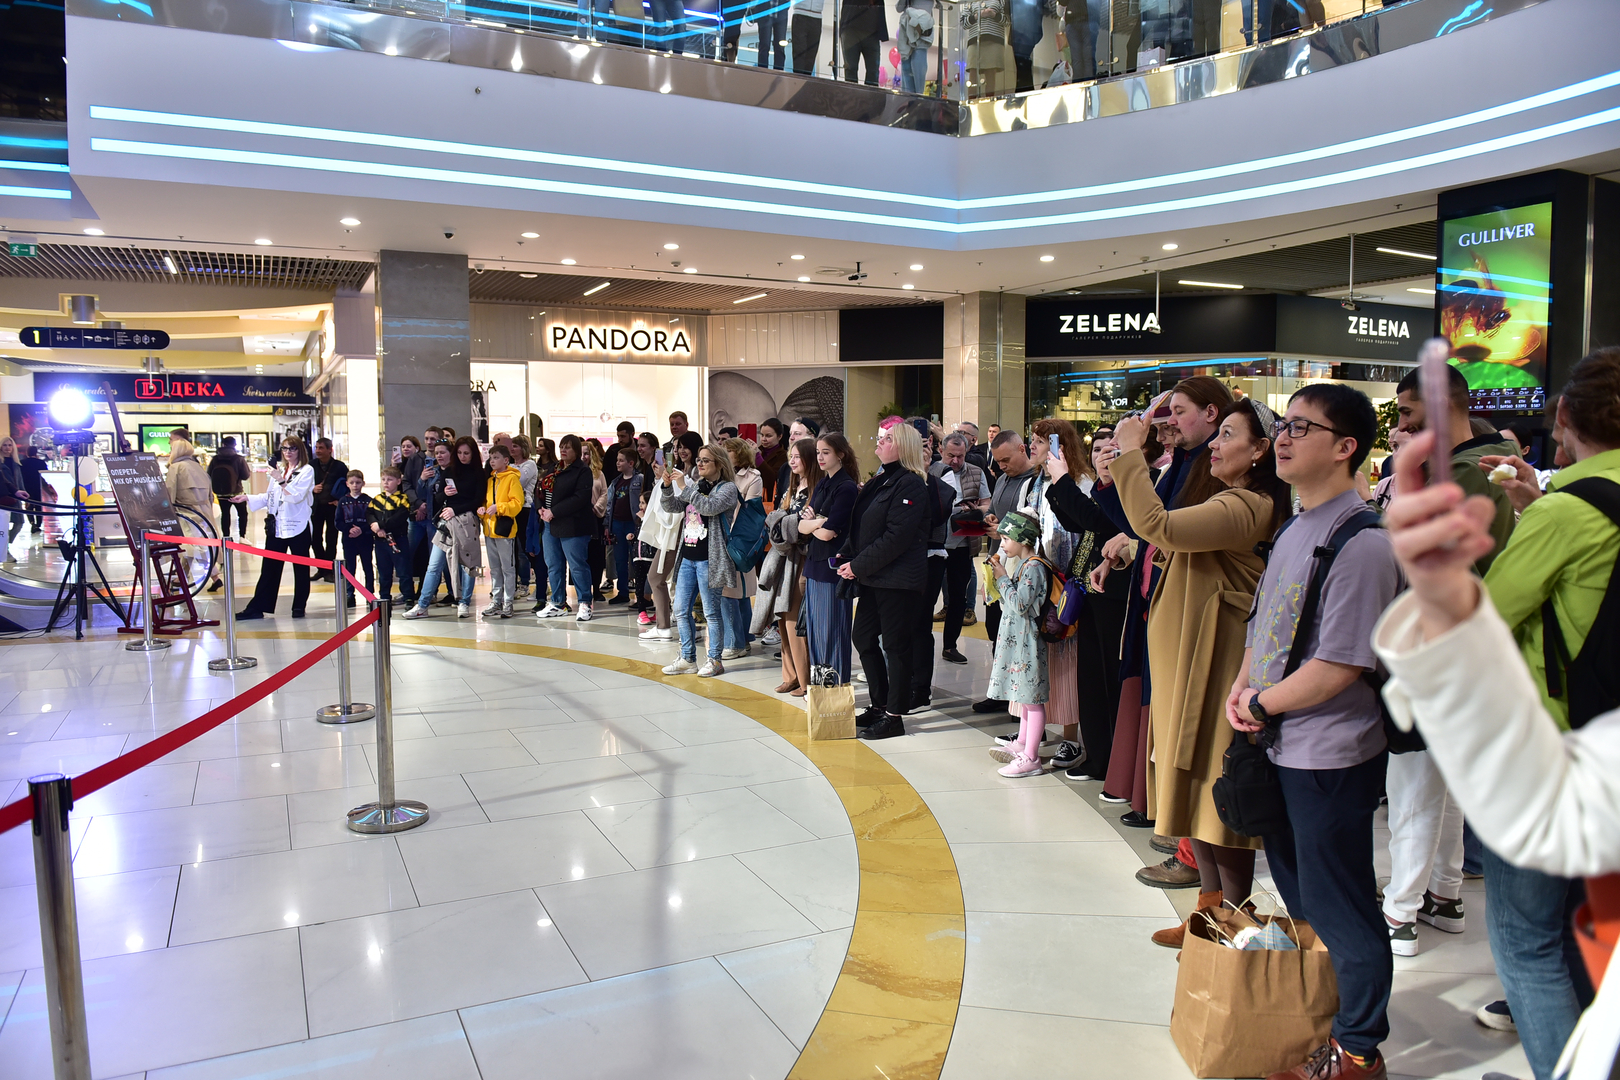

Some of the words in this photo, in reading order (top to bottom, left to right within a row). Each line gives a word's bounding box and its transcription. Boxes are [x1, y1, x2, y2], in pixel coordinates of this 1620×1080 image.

[1458, 222, 1535, 247] GULLIVER
[1059, 312, 1161, 333] ZELENA
[1347, 315, 1410, 339] ZELENA
[33, 330, 40, 344] 1
[552, 326, 691, 353] PANDORA
[170, 382, 225, 398] ДЕКА
[242, 384, 265, 397] Swiss
[265, 388, 297, 398] watches
